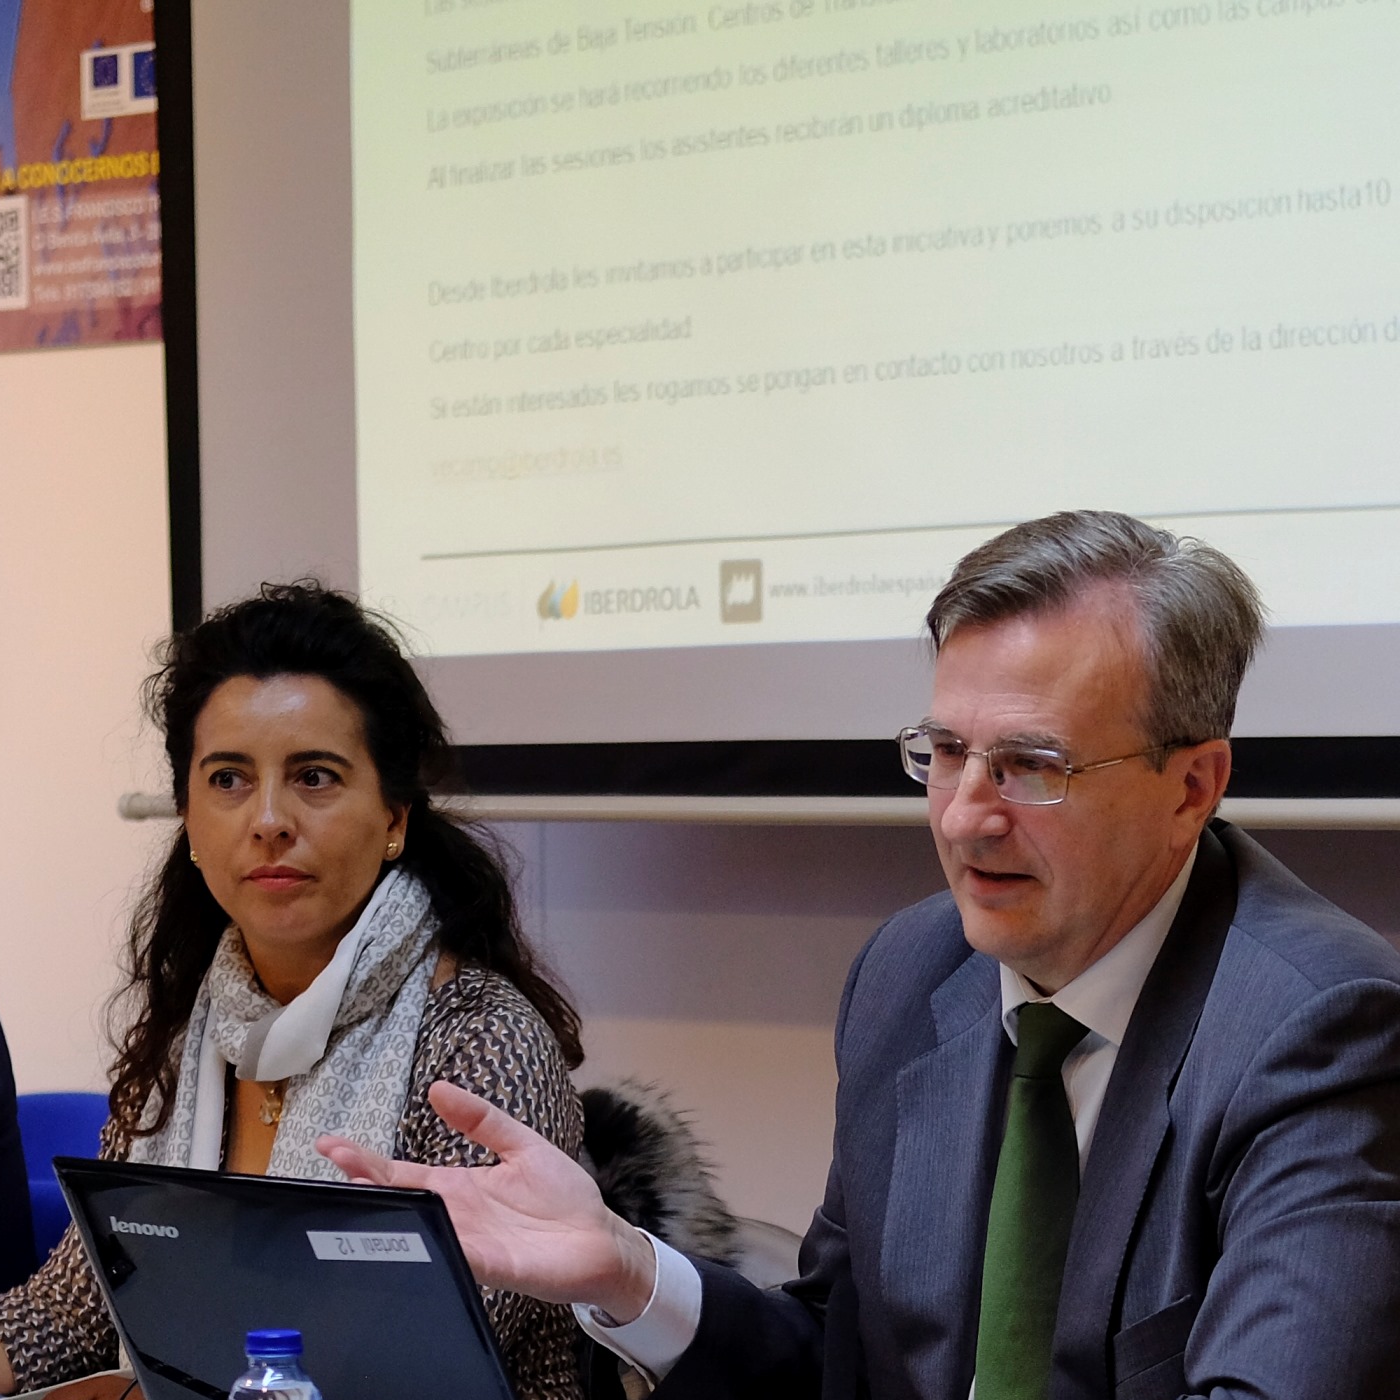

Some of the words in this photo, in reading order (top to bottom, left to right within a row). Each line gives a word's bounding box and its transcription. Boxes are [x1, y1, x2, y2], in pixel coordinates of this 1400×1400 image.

[547, 27, 571, 55] de
[549, 91, 575, 114] se
[738, 61, 768, 87] los
[772, 49, 870, 83] diferentes
[875, 37, 951, 68] talleres
[956, 37, 969, 62] y
[974, 17, 1100, 54] laboratorios
[1148, 5, 1211, 32] como
[520, 153, 548, 178] las
[551, 143, 635, 172] sesiones
[639, 137, 667, 162] los
[670, 123, 770, 157] asistentes
[868, 111, 894, 133] un
[898, 97, 980, 132] diploma
[428, 278, 485, 307] Desde
[572, 264, 599, 290] les
[604, 258, 696, 286] invitamos
[699, 255, 713, 276] a
[716, 243, 804, 277] participar
[810, 239, 836, 264] en
[842, 233, 887, 260] esta
[985, 225, 999, 251] y
[1005, 211, 1103, 247] ponemos
[1111, 209, 1126, 233] a
[1132, 206, 1159, 231] su
[1164, 189, 1292, 229] disposición
[429, 339, 490, 364] Centro
[493, 336, 522, 361] por
[526, 327, 571, 354] cada
[505, 382, 609, 415] interesados
[613, 379, 640, 404] les
[646, 375, 731, 406] rogamos
[736, 372, 760, 395] se
[763, 364, 837, 396] pongan
[842, 360, 869, 385] en
[875, 350, 962, 382] contacto
[966, 348, 1004, 373] con
[1010, 341, 1103, 369] nosotros
[1110, 338, 1125, 363] a
[1132, 333, 1199, 362] través
[1205, 327, 1235, 354] de
[1241, 326, 1262, 352] la
[1268, 318, 1377, 351] dirección
[583, 585, 700, 617] IBERDROLA
[109, 1214, 180, 1240] lenovo
